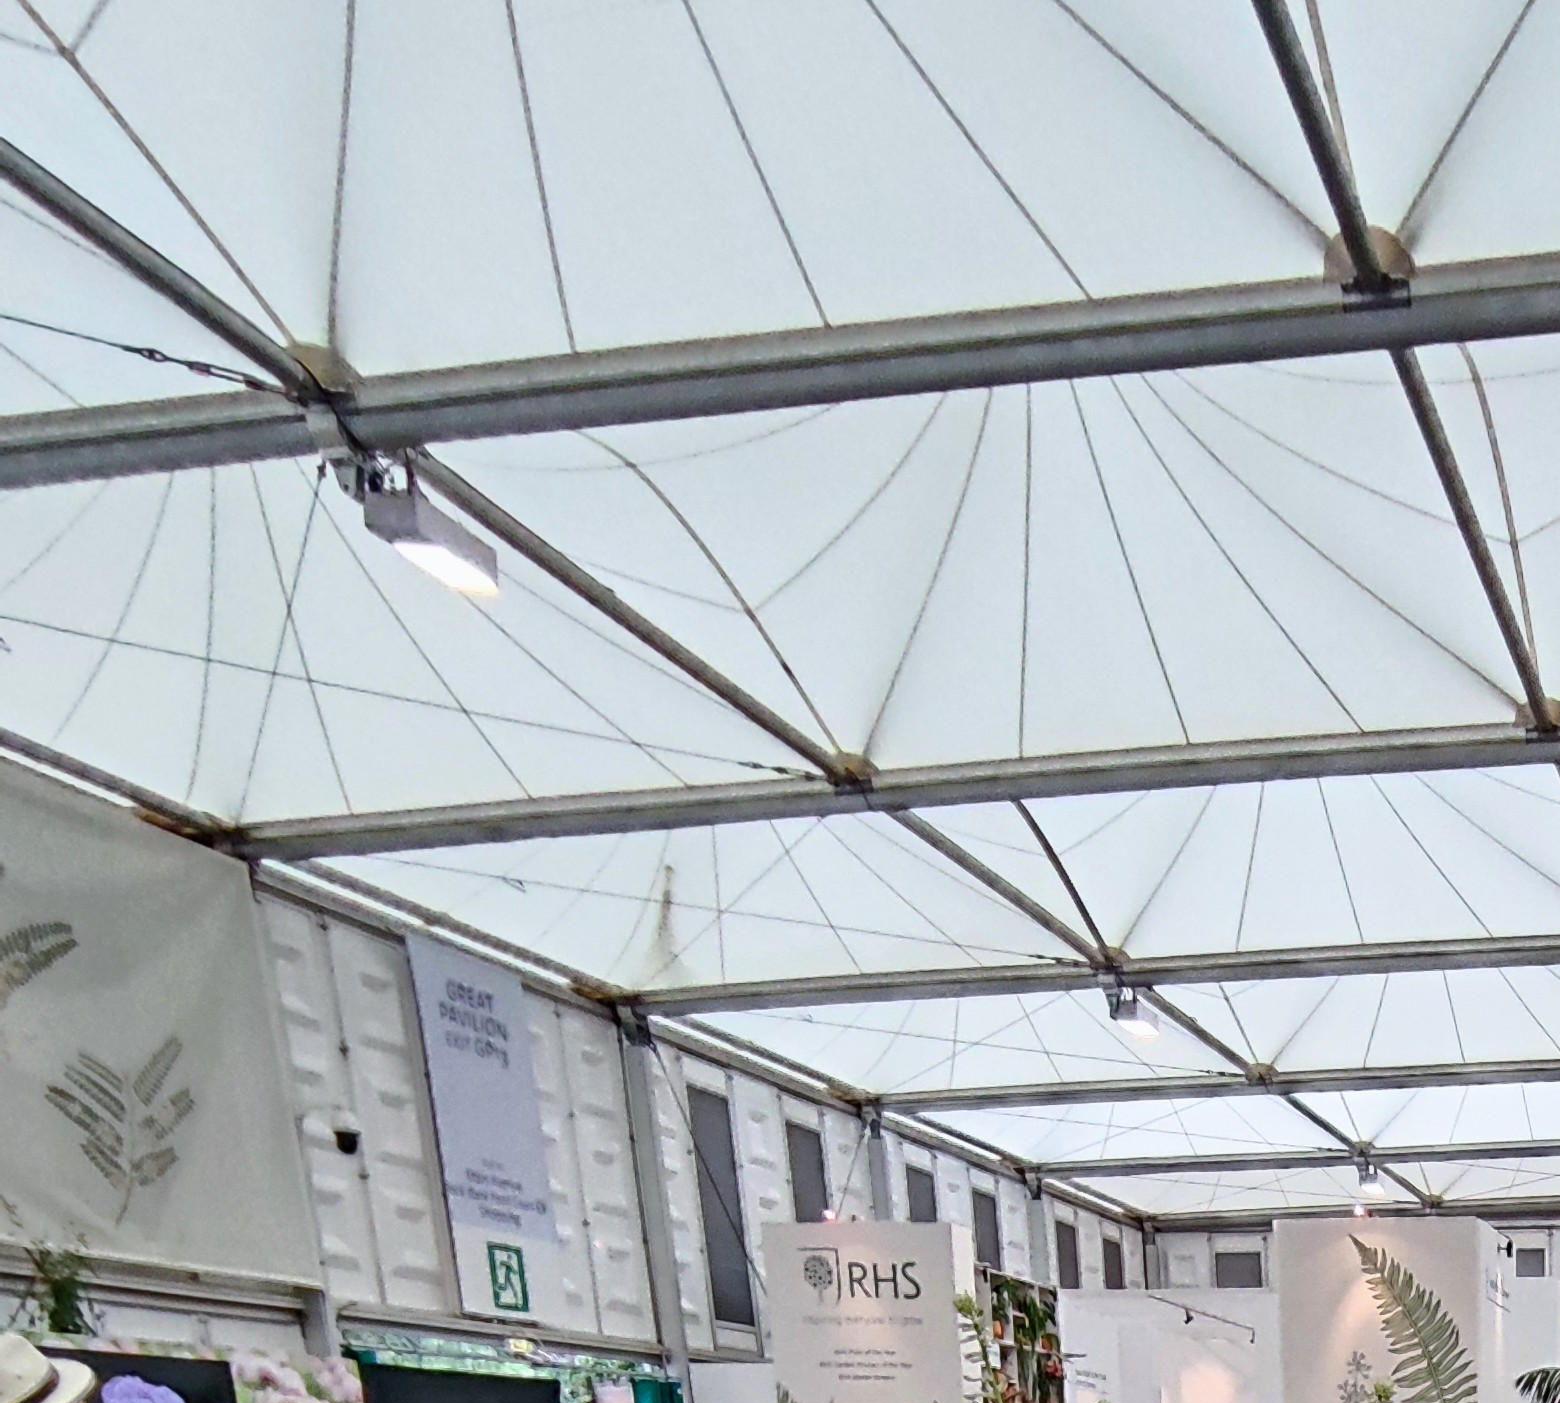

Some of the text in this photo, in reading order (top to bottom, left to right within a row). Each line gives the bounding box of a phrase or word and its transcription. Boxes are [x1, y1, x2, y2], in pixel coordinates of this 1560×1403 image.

[445, 979, 493, 1013] GREAT
[439, 1001, 508, 1042] PAVILION
[847, 1261, 922, 1300] RHS
